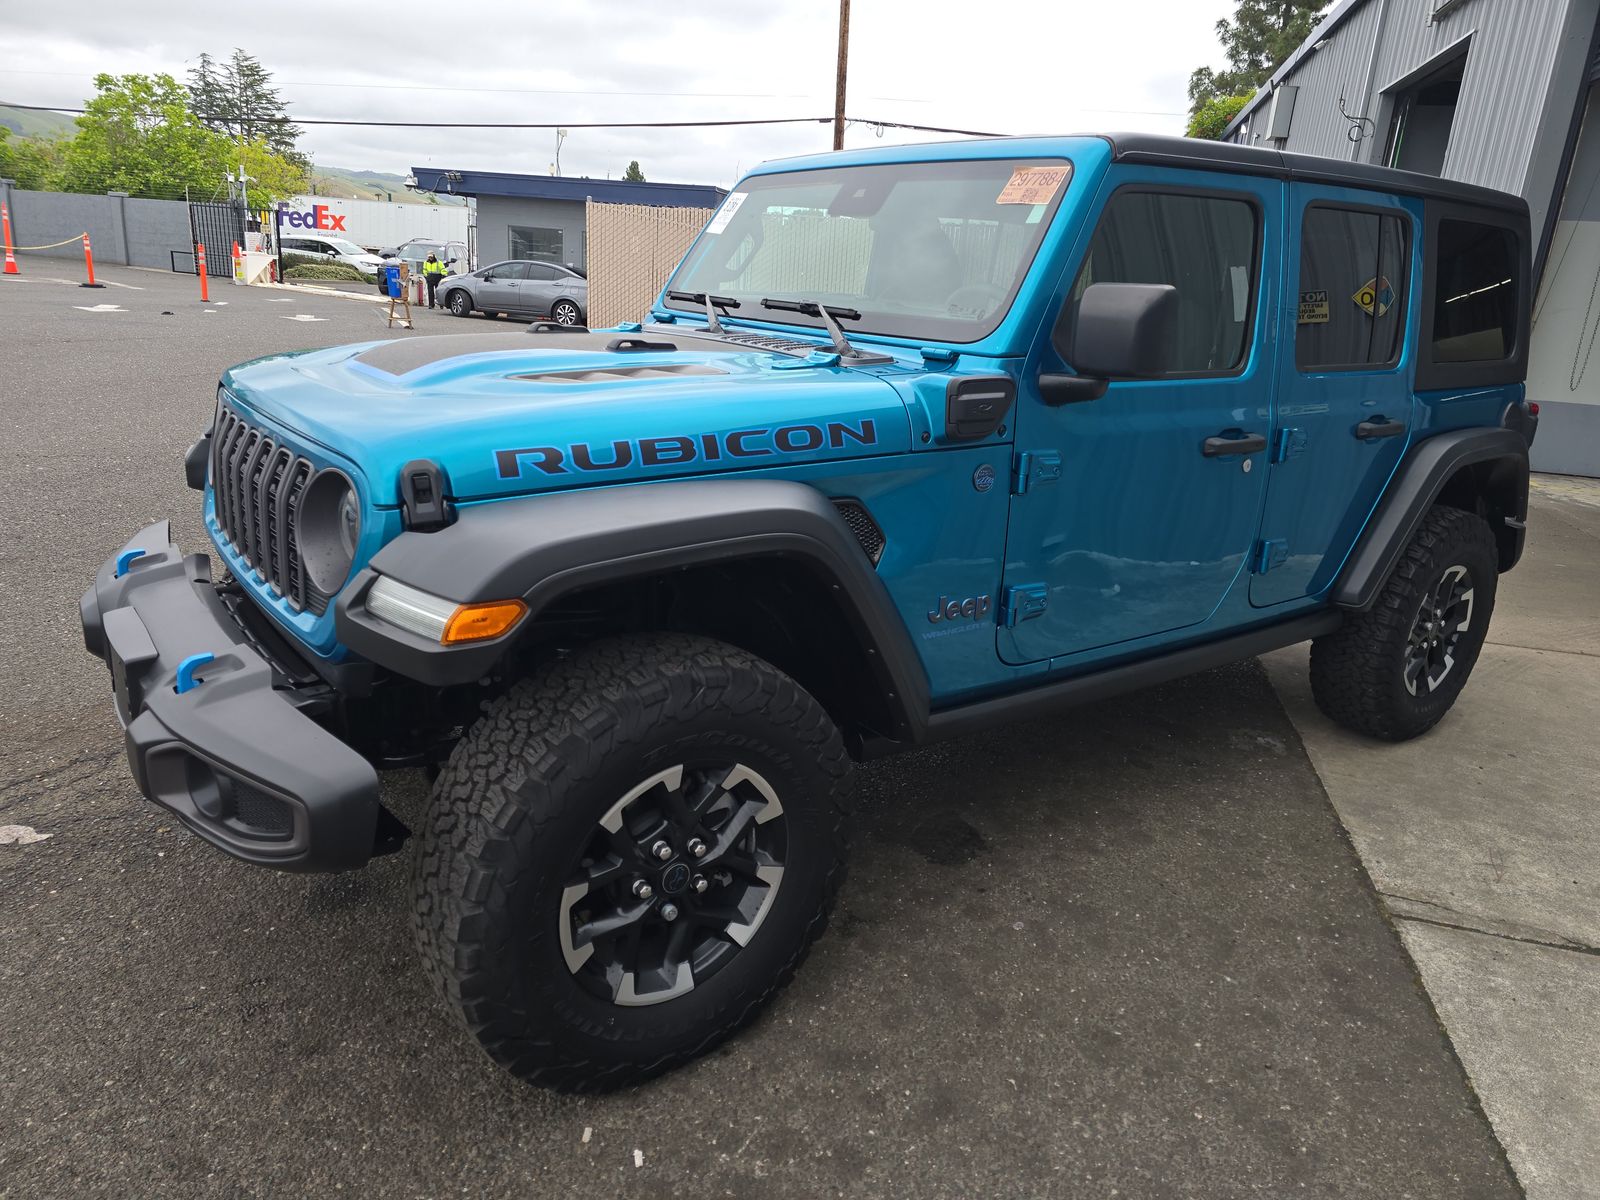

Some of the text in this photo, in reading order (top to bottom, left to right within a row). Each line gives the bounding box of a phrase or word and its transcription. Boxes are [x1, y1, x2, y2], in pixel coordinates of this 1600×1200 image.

[278, 202, 346, 231] FedEx
[492, 417, 878, 480] RUBICON
[928, 595, 992, 624] Jeep
